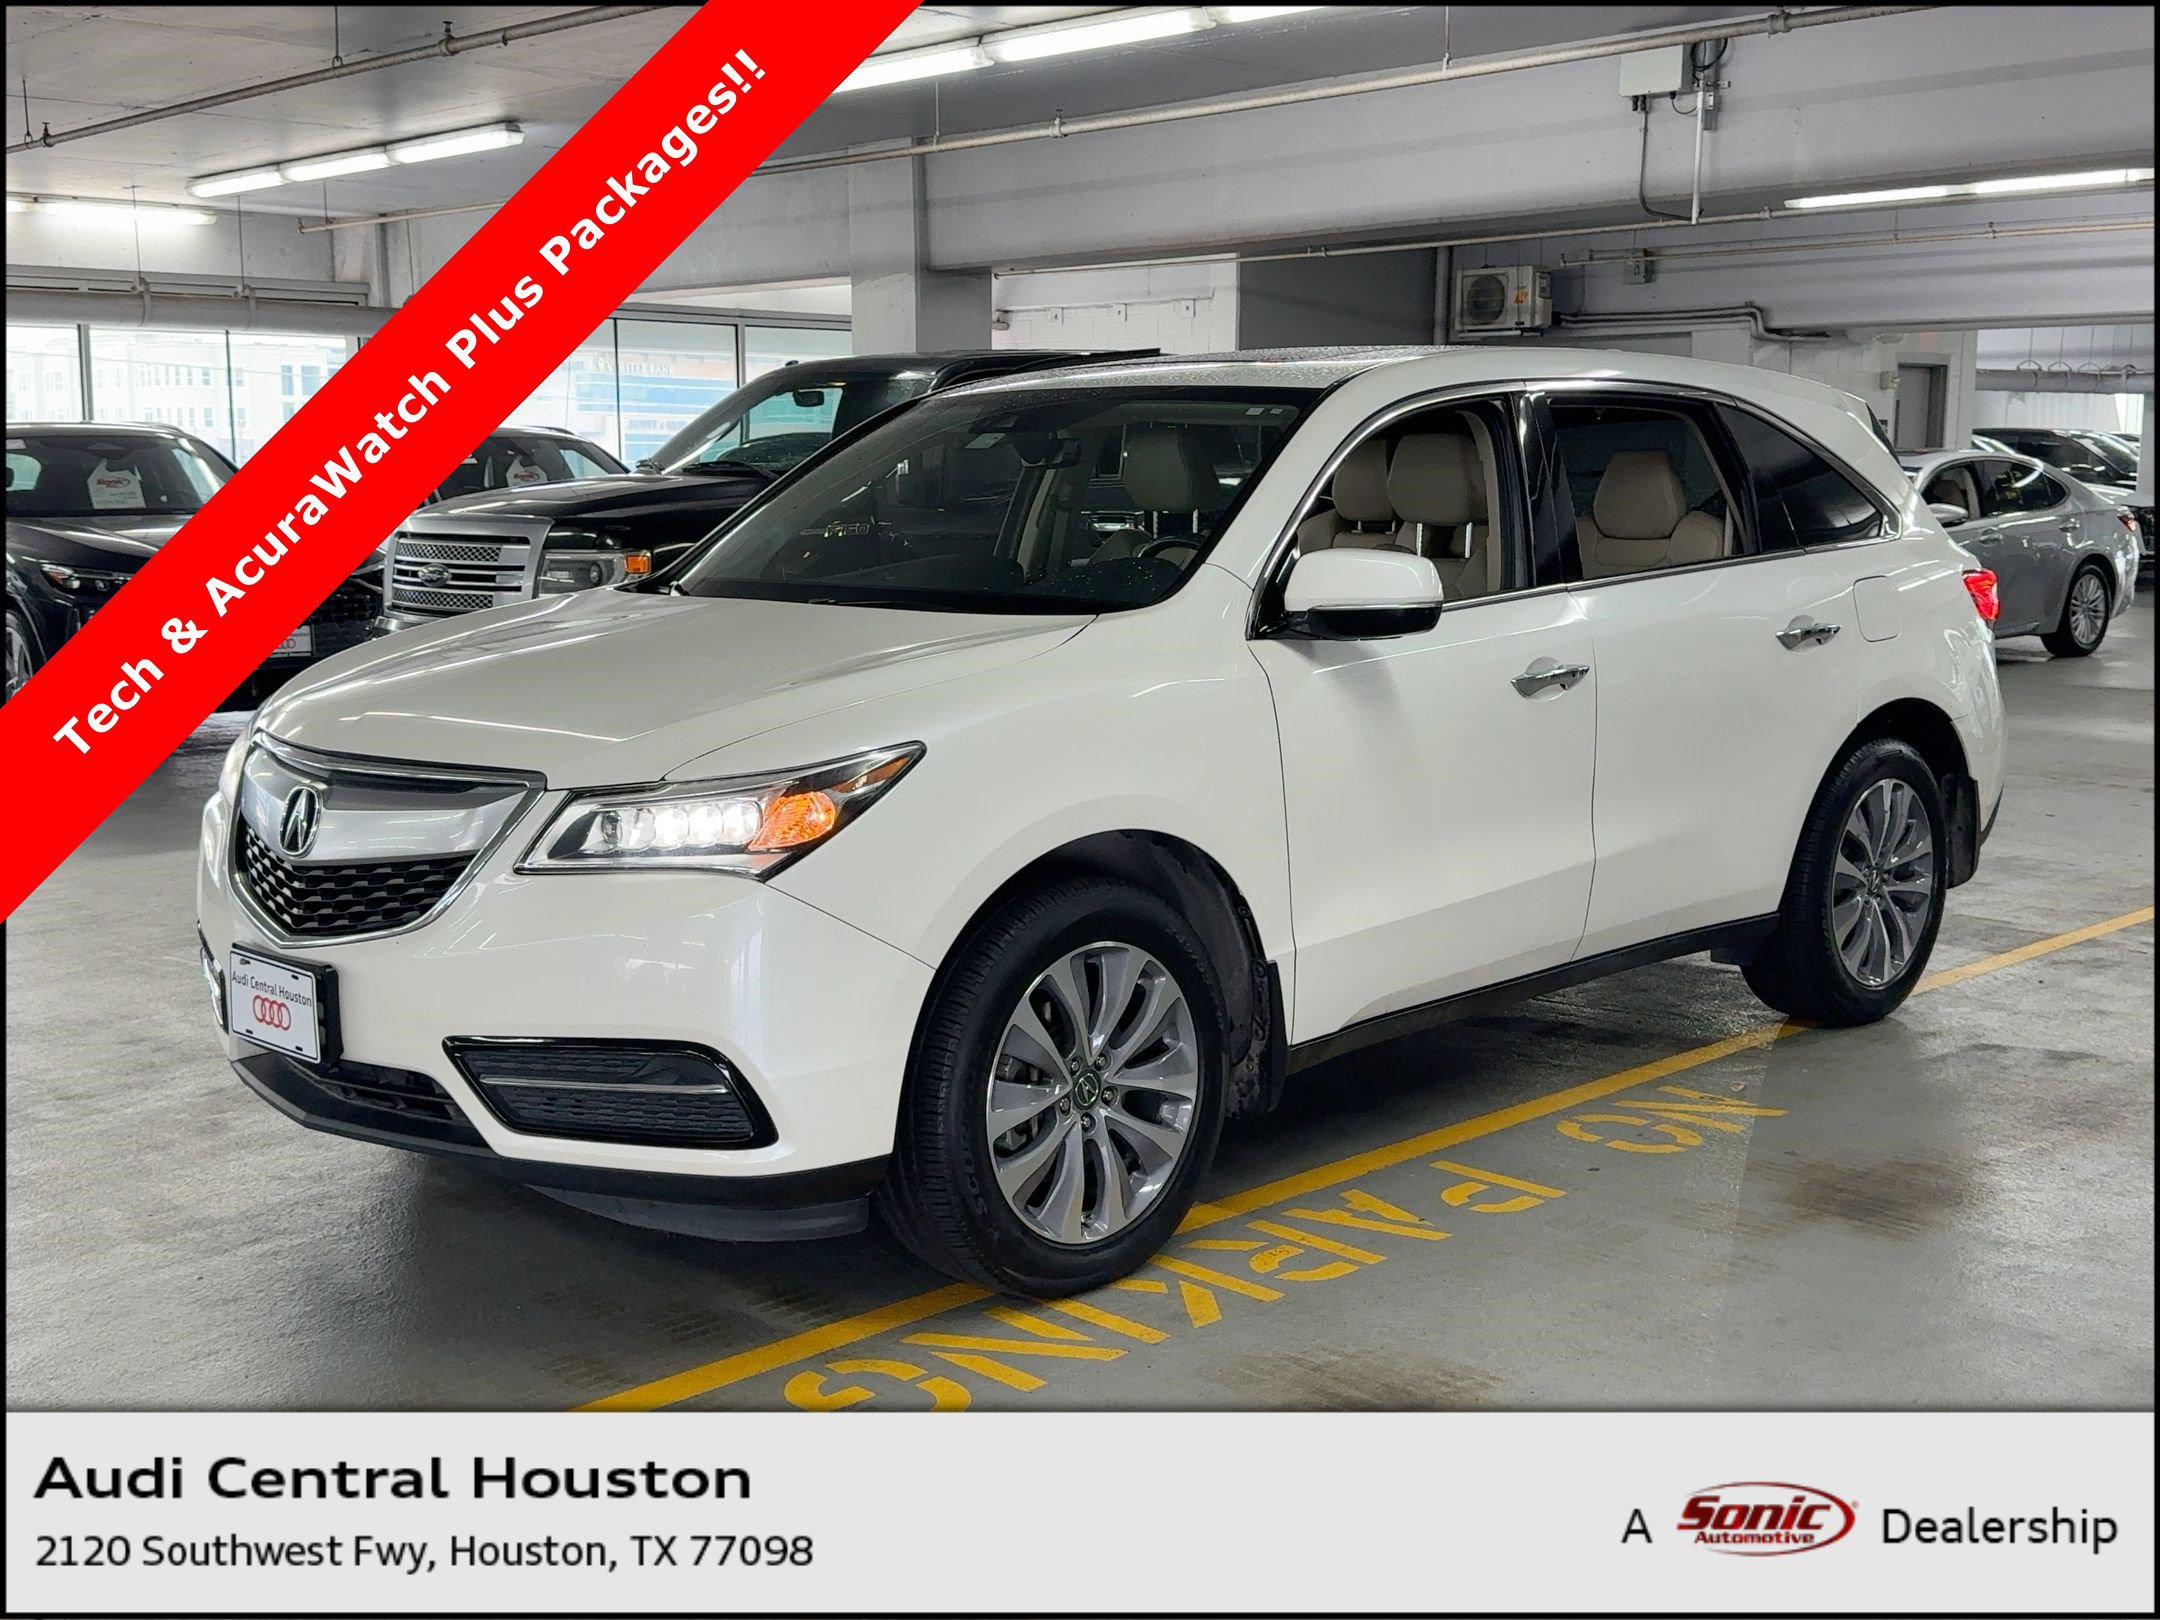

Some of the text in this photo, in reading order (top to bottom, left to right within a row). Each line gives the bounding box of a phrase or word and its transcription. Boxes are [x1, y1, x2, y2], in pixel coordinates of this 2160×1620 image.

[232, 970, 312, 1007] Audi Central Houston
[1556, 1085, 1790, 1154] NO
[784, 1160, 1567, 1413] PARKING
